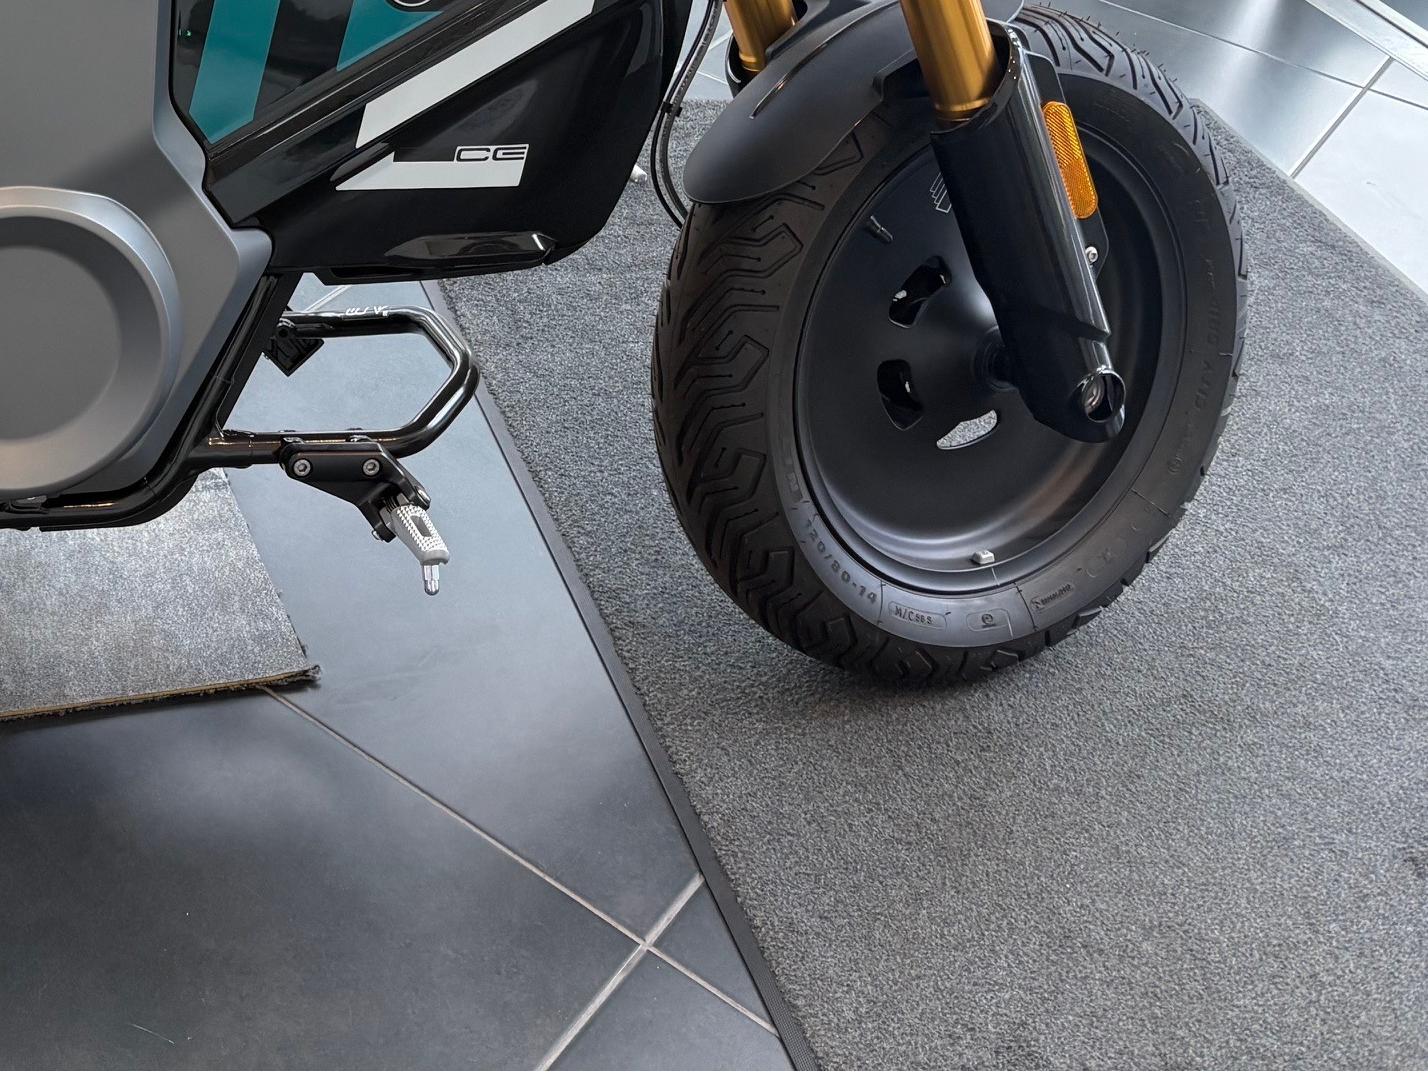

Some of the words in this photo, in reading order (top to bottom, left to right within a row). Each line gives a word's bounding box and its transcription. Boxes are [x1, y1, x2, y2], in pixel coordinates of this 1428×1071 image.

[456, 145, 527, 162] CE
[803, 518, 877, 605] 120/80-14
[895, 605, 914, 622] M/C
